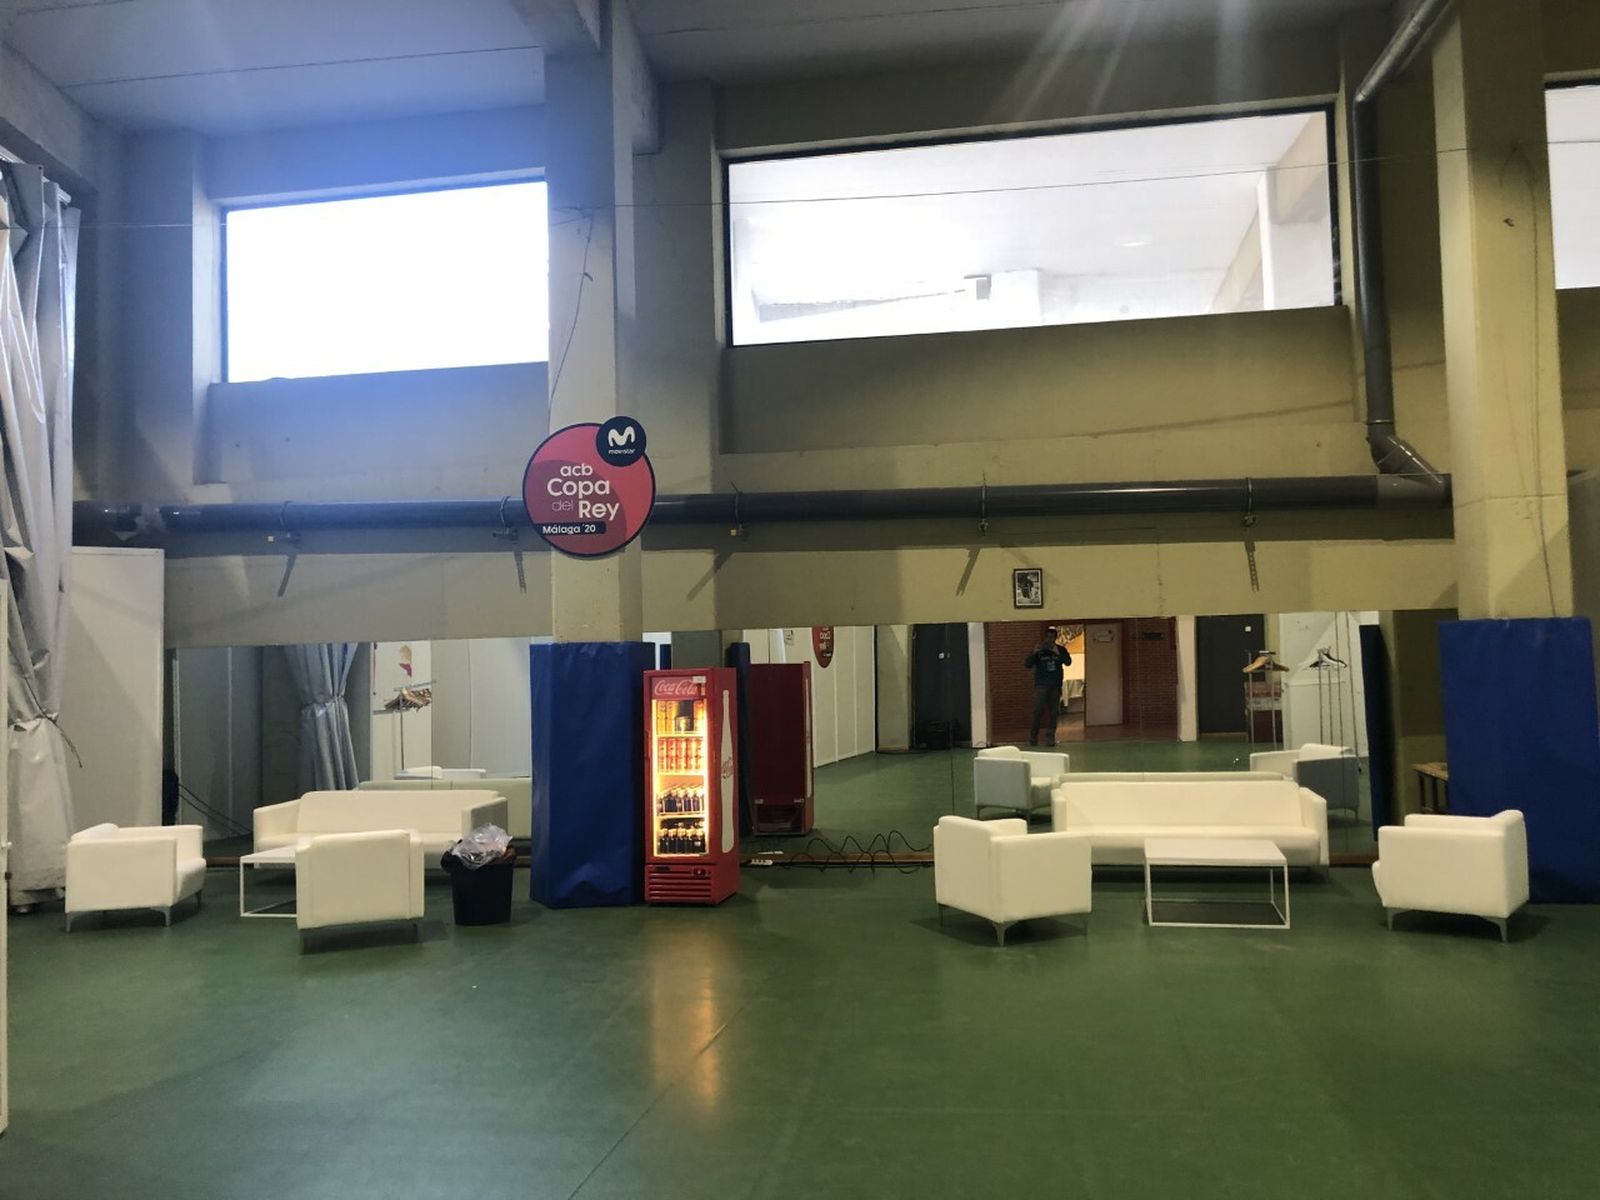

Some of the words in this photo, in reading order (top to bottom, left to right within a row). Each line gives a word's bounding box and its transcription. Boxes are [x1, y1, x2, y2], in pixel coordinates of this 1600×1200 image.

[560, 463, 593, 477] acb
[547, 478, 610, 499] Copa
[551, 500, 574, 512] del
[578, 500, 620, 521] Rey
[542, 524, 581, 535] Málaga
